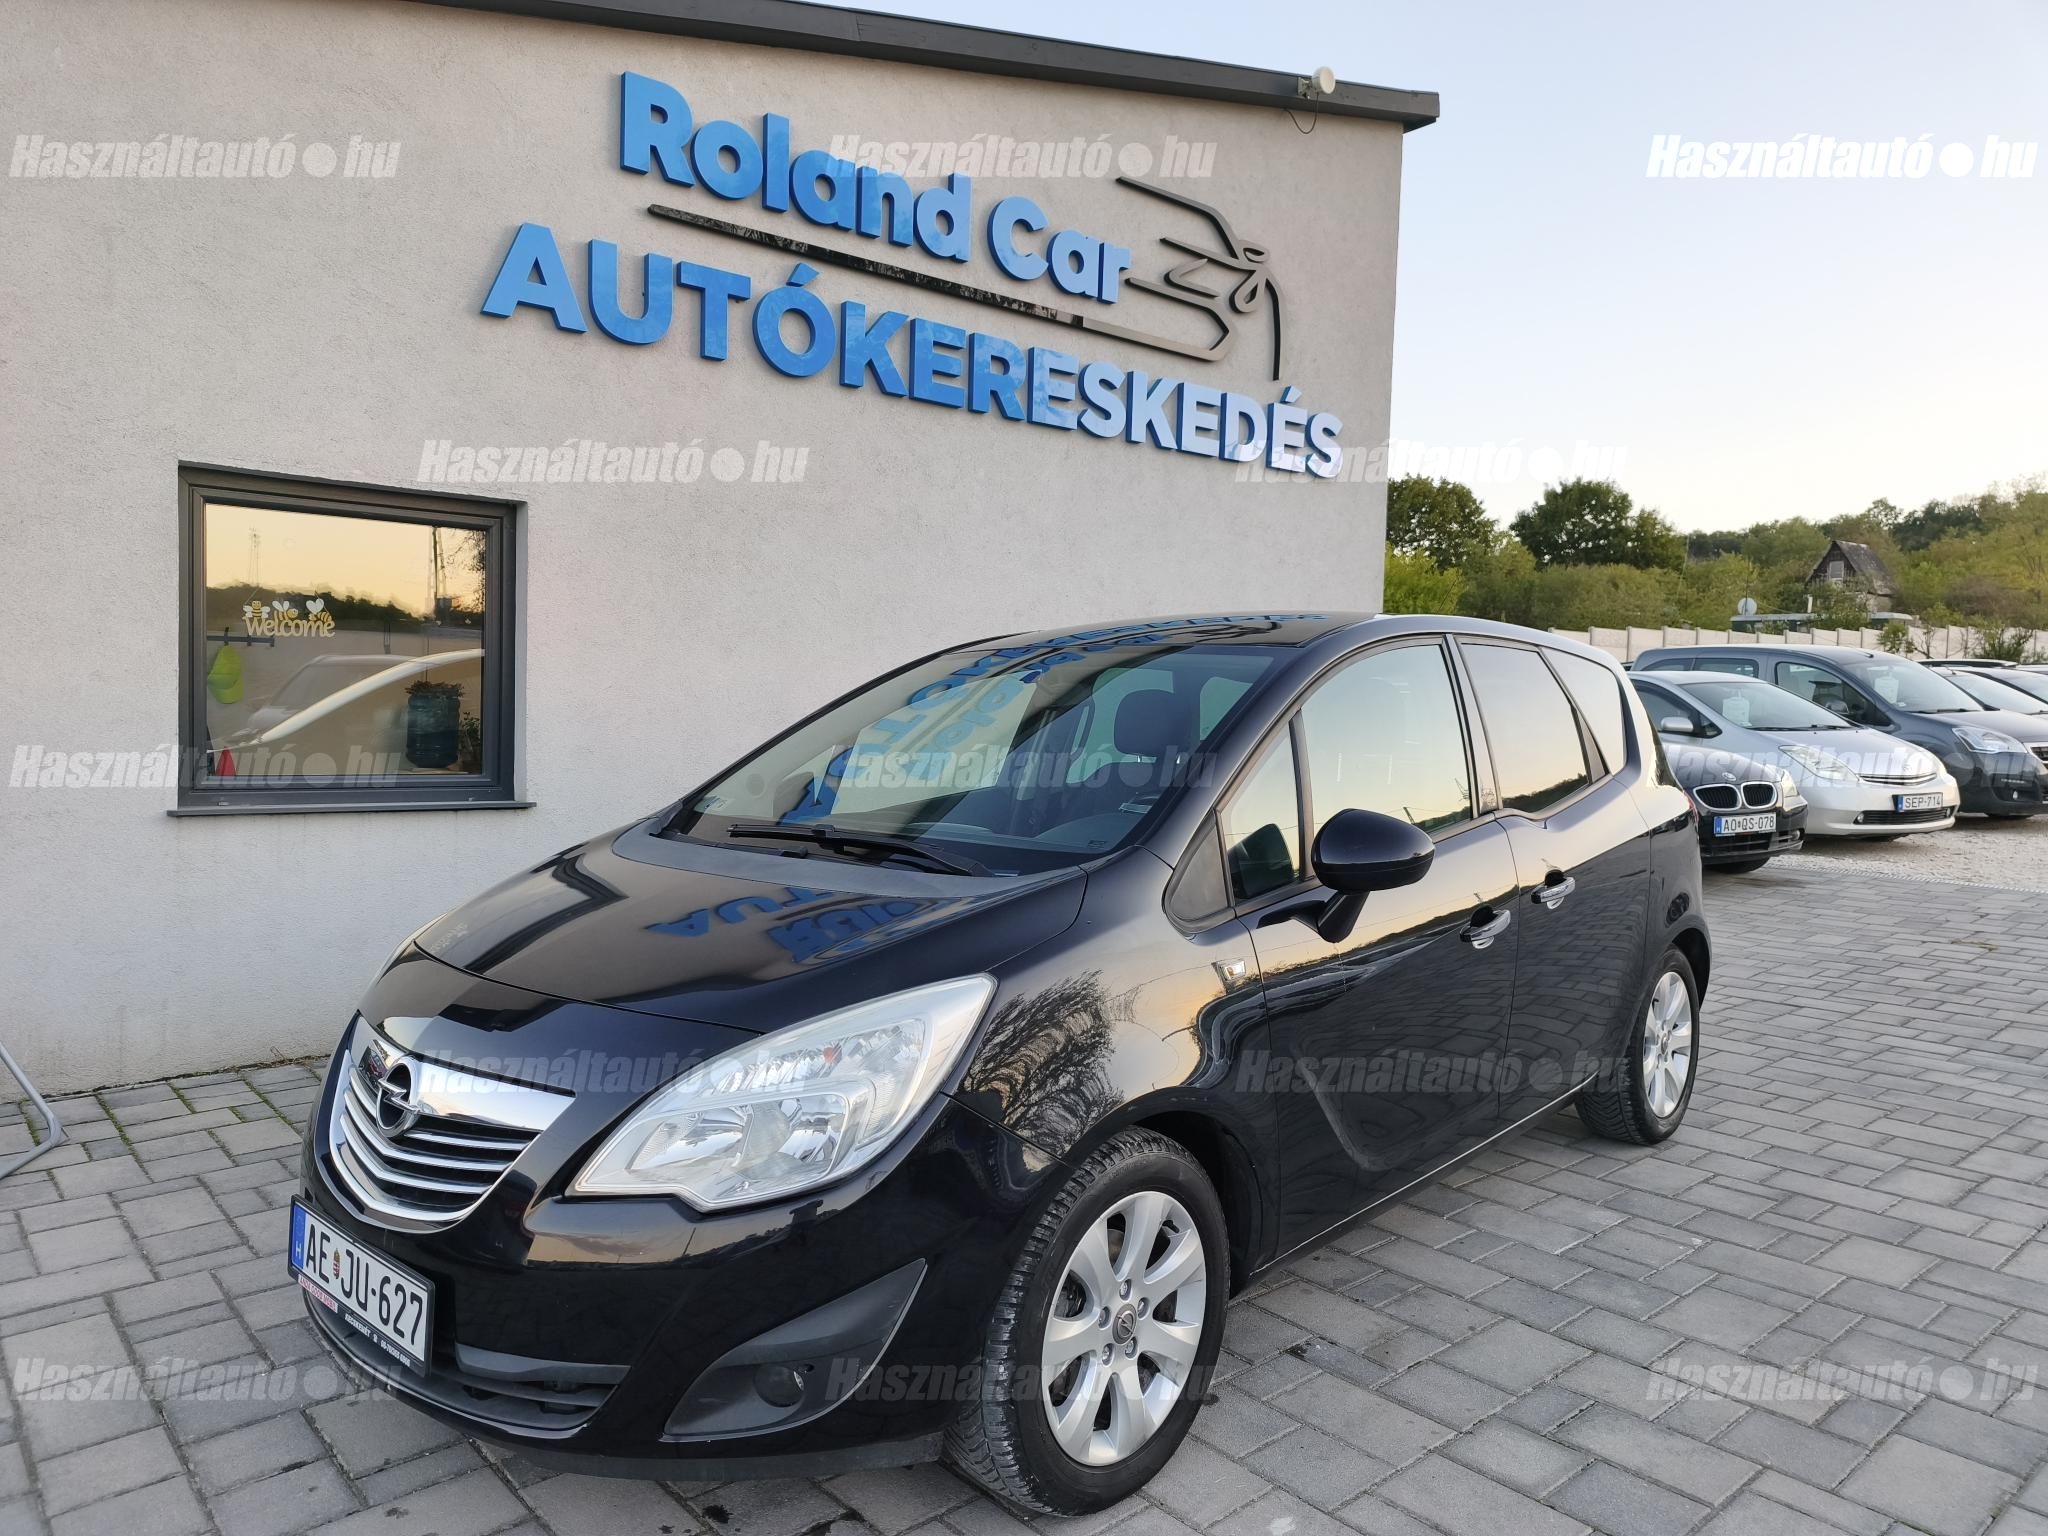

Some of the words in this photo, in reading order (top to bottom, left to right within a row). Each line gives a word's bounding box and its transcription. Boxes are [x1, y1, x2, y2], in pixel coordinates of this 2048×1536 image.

[620, 71, 973, 264] Roland
[987, 196, 1132, 305] Car
[480, 222, 1343, 478] AUTÓKERESKEDÉS
[1905, 795, 1941, 809] SEP-714
[306, 1223, 331, 1284] AE
[341, 1248, 424, 1346] JU-627
